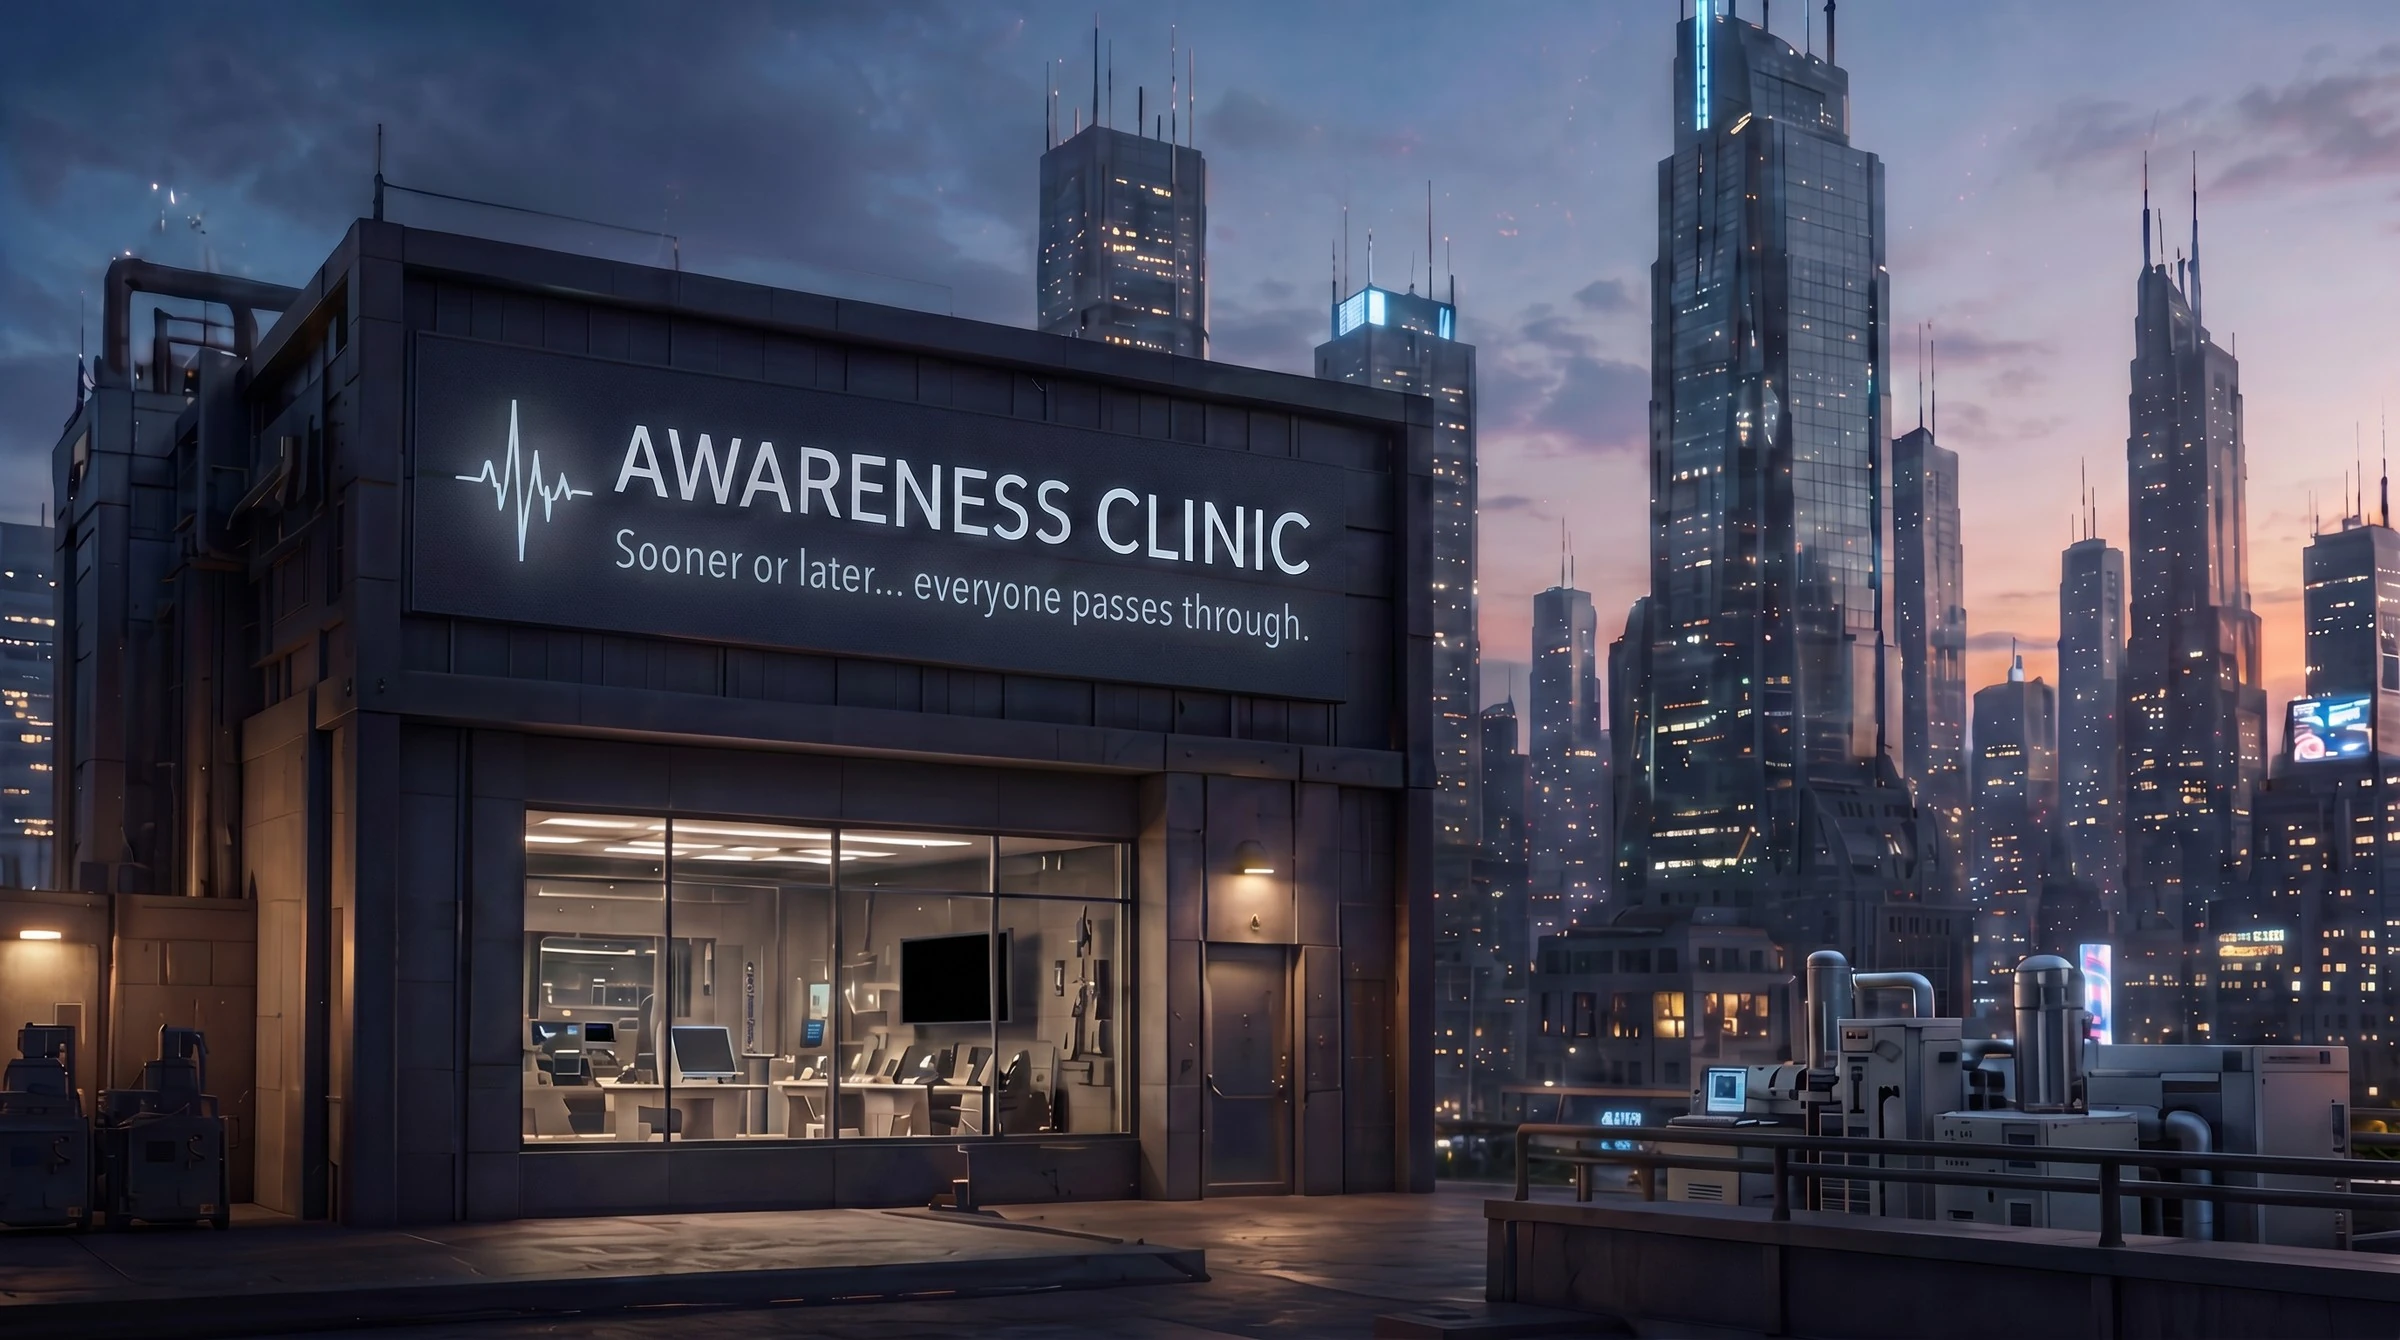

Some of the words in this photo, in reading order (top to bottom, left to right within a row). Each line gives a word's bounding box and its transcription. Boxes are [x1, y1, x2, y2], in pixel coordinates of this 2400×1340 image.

[614, 424, 1072, 546] AWARENESS
[1097, 487, 1312, 576] CLINIC
[614, 527, 744, 581] Sooner
[753, 555, 790, 586] or
[799, 546, 904, 599] later...
[914, 572, 1062, 619] everyone
[1073, 590, 1174, 629] passes
[1181, 596, 1310, 649] through.
